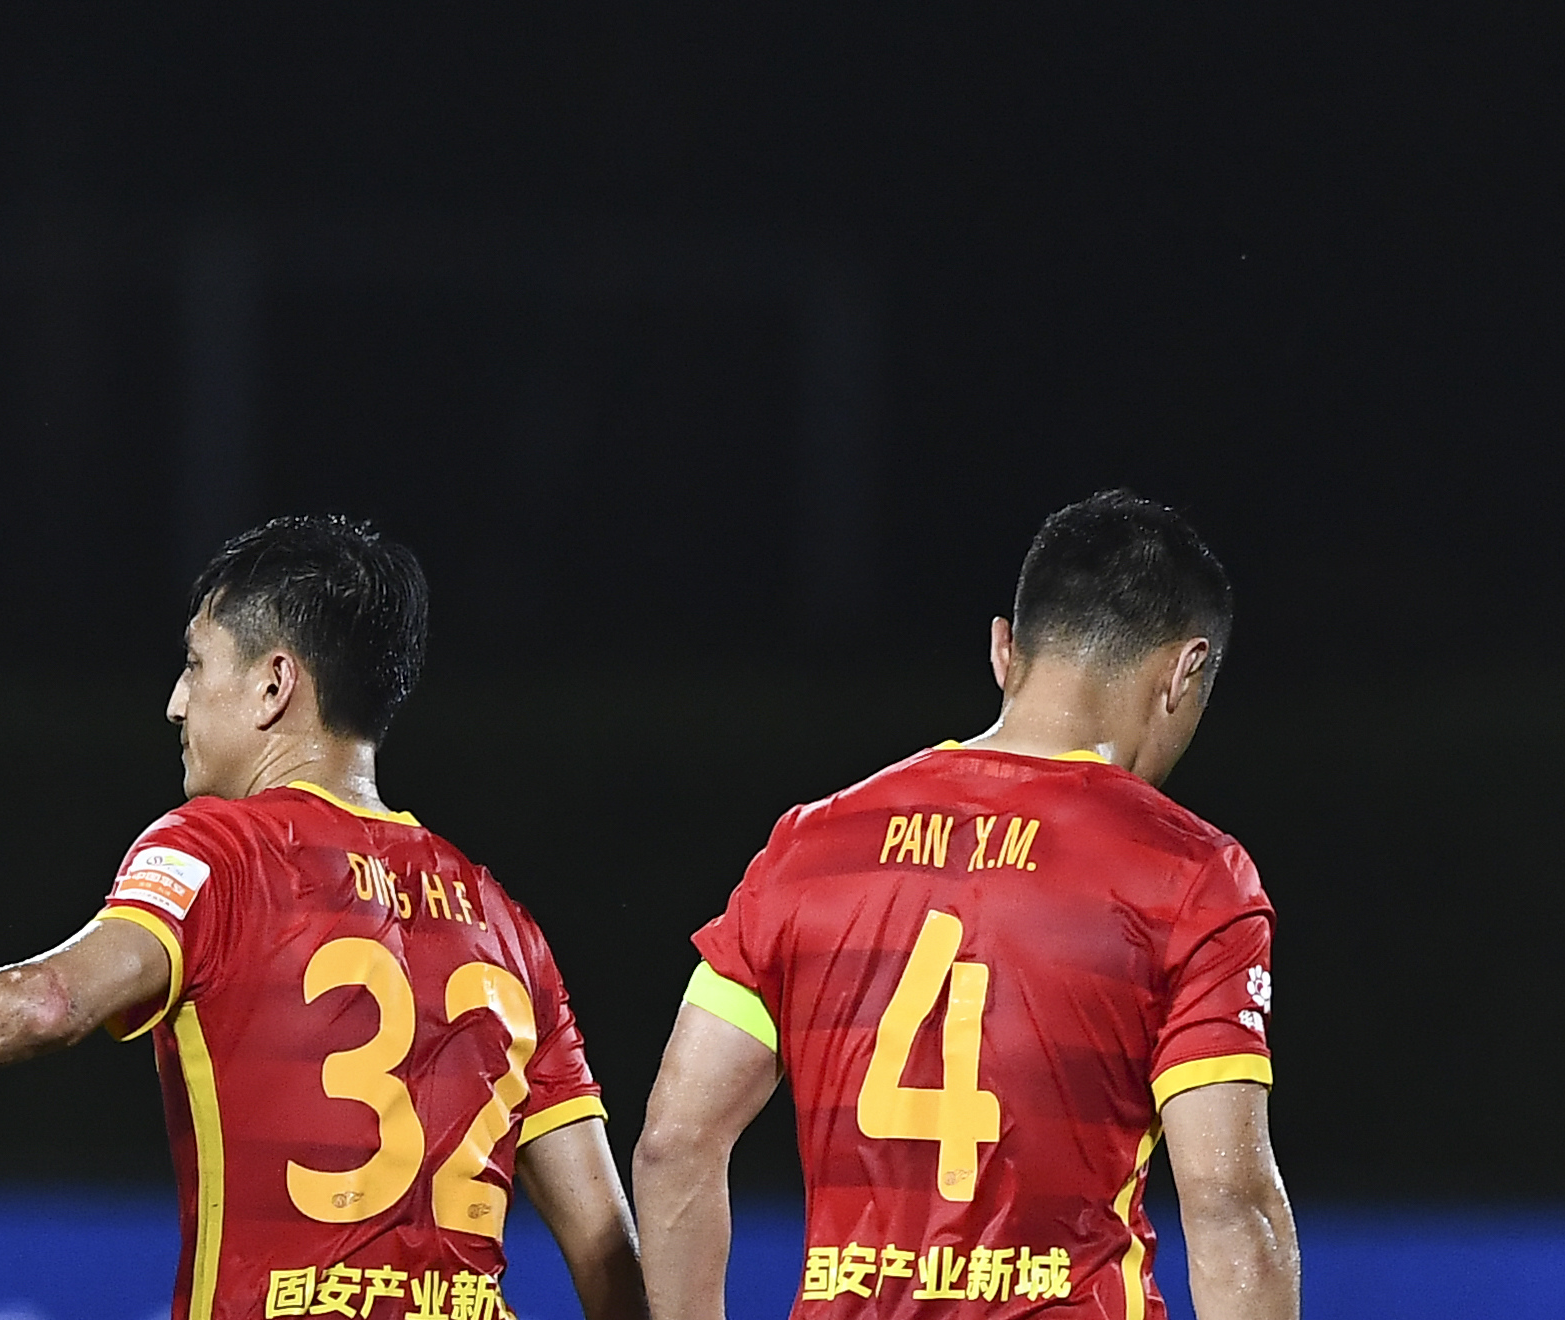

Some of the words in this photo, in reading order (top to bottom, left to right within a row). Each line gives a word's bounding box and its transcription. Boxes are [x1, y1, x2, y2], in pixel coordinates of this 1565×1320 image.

[879, 813, 954, 869] PAN
[967, 815, 1040, 873] X.M.
[285, 936, 538, 1242] 32
[857, 909, 1001, 1202] 4
[802, 1241, 1072, 1302] 固安产业新城
